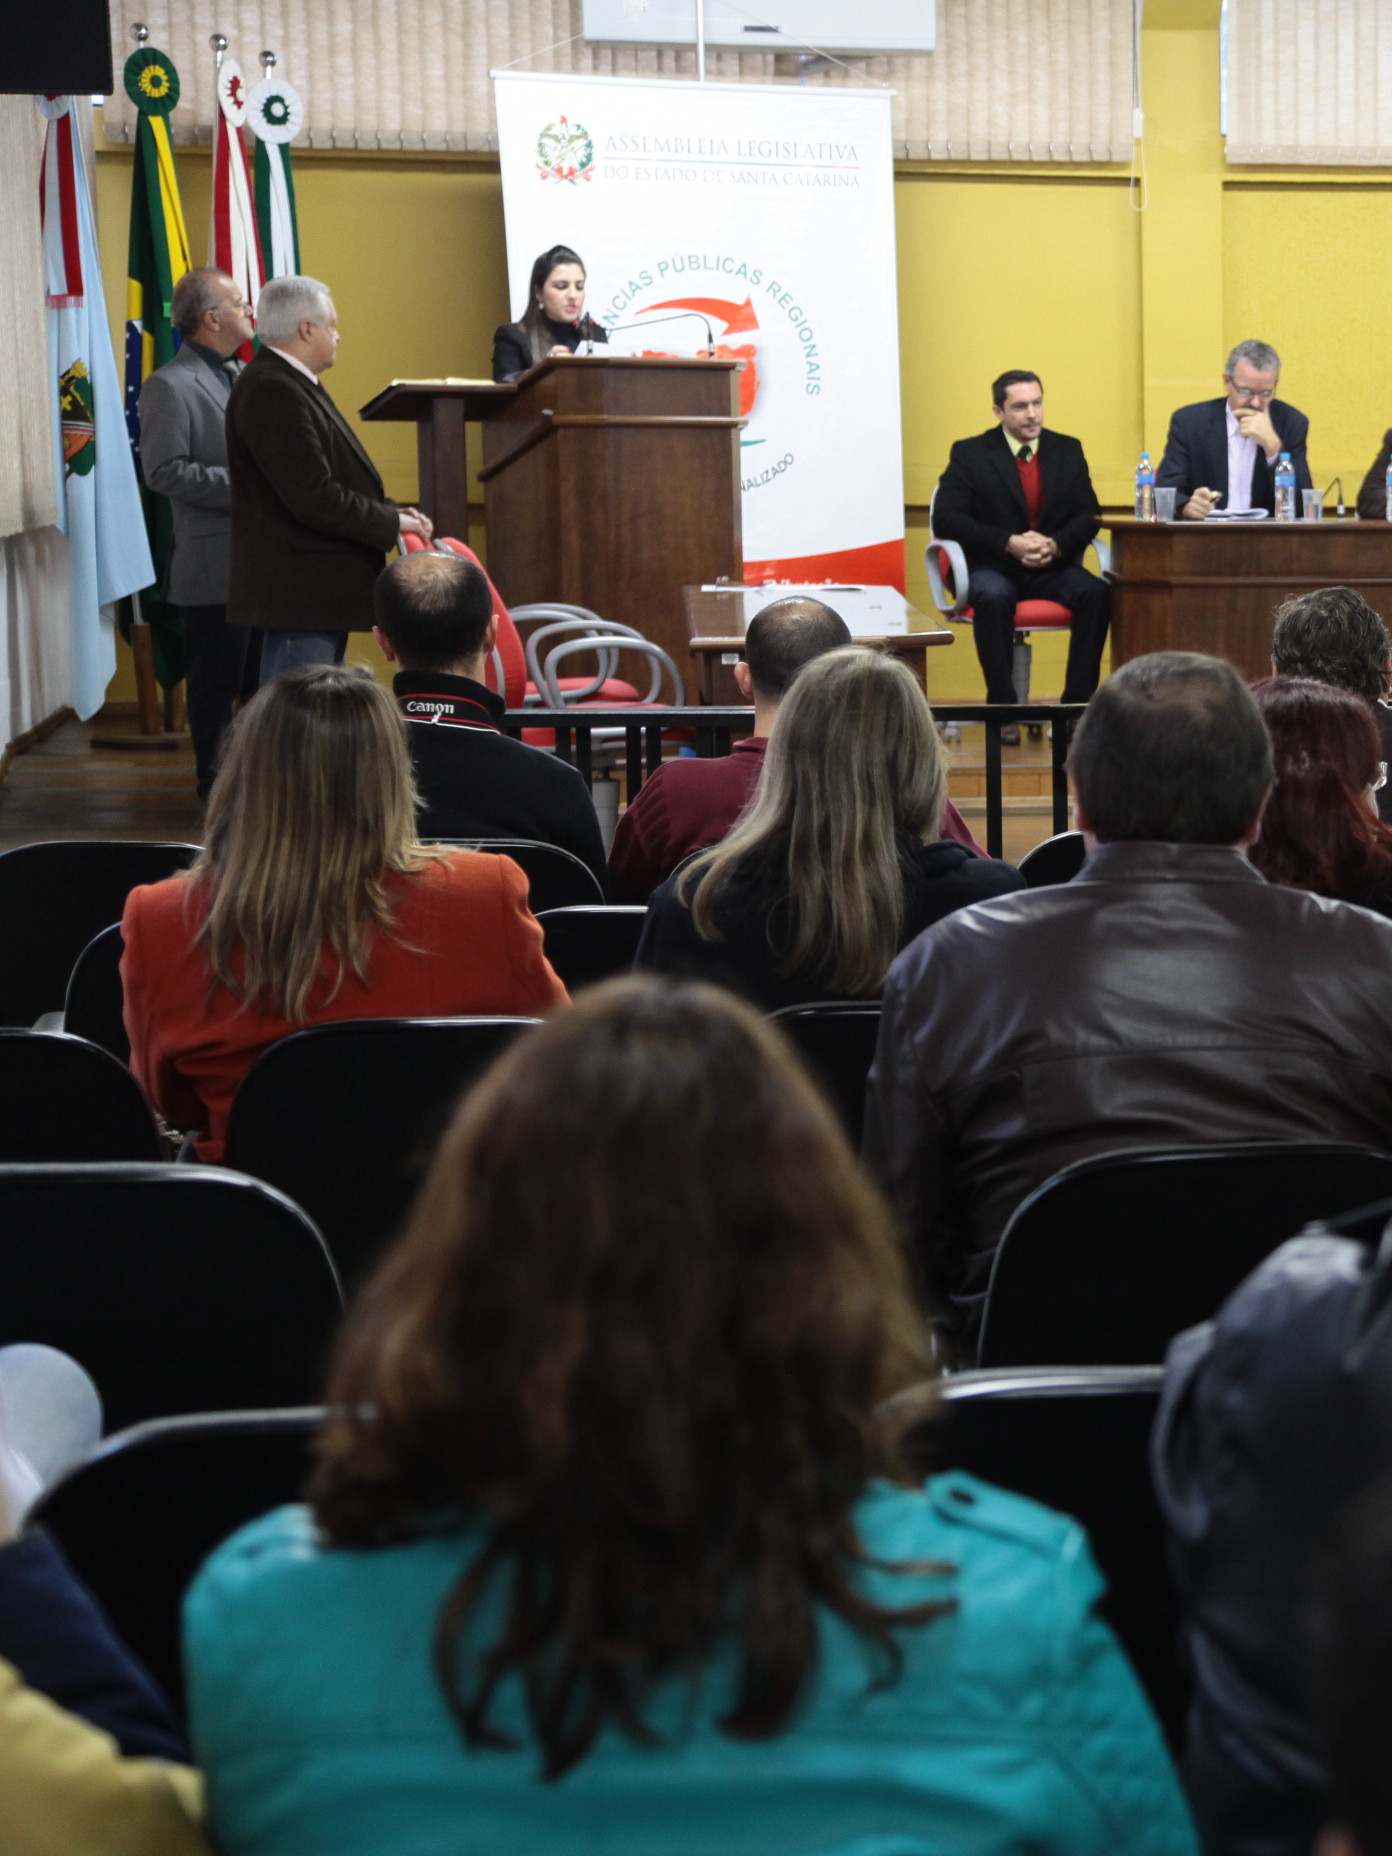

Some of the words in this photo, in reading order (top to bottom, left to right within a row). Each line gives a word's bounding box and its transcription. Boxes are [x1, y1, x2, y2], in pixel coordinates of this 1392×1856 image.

[604, 134, 729, 156] ASSEMBLEIA
[737, 139, 859, 161] LEGISLATIVA
[603, 165, 629, 180] DO
[635, 166, 697, 182] ESTADO
[703, 168, 724, 184] DE
[729, 169, 778, 186] SANTA
[782, 171, 860, 188] CATARINA
[601, 270, 654, 326] NCIAS
[657, 252, 763, 286] PÚBLICAS
[766, 280, 821, 397] REGIONAIS
[406, 701, 455, 714] Canon
